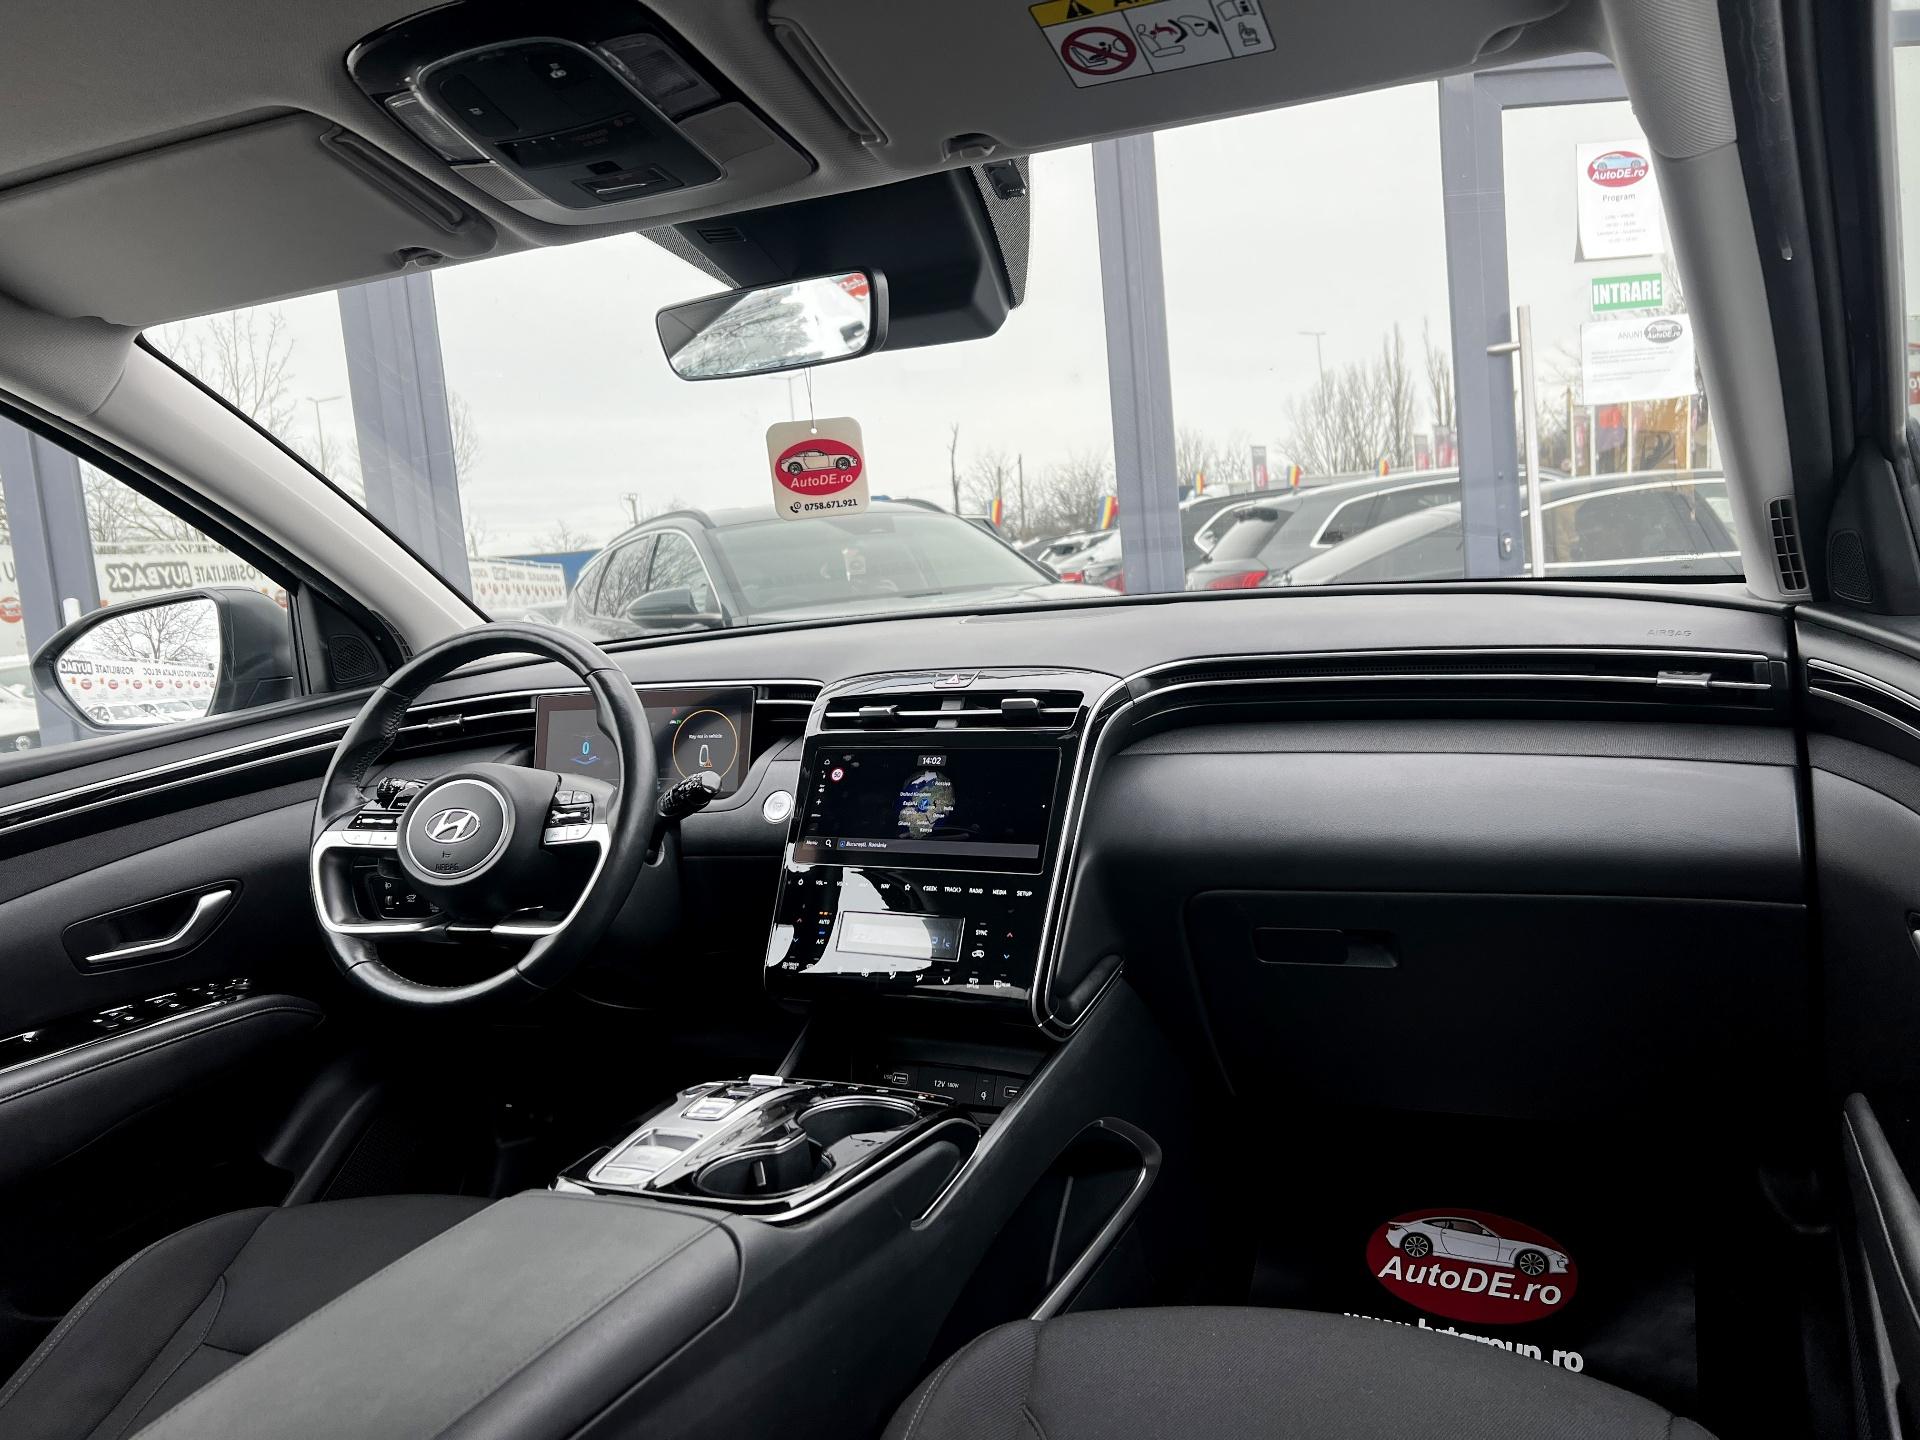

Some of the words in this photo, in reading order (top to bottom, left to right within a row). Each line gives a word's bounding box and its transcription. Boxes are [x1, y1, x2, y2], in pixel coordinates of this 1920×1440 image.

[1592, 167, 1645, 181] AutoDE.ro
[1602, 193, 1636, 203] Program
[1593, 280, 1661, 305] INTRARE
[791, 473, 853, 488] AutoDE.ro
[804, 499, 858, 511] 0758.671.921
[1647, 629, 1692, 637] AIRBAG
[582, 741, 590, 755] 0
[922, 756, 942, 765] 14:02
[934, 1080, 946, 1088] 12V
[1378, 1255, 1562, 1305] AutoDE.ro
